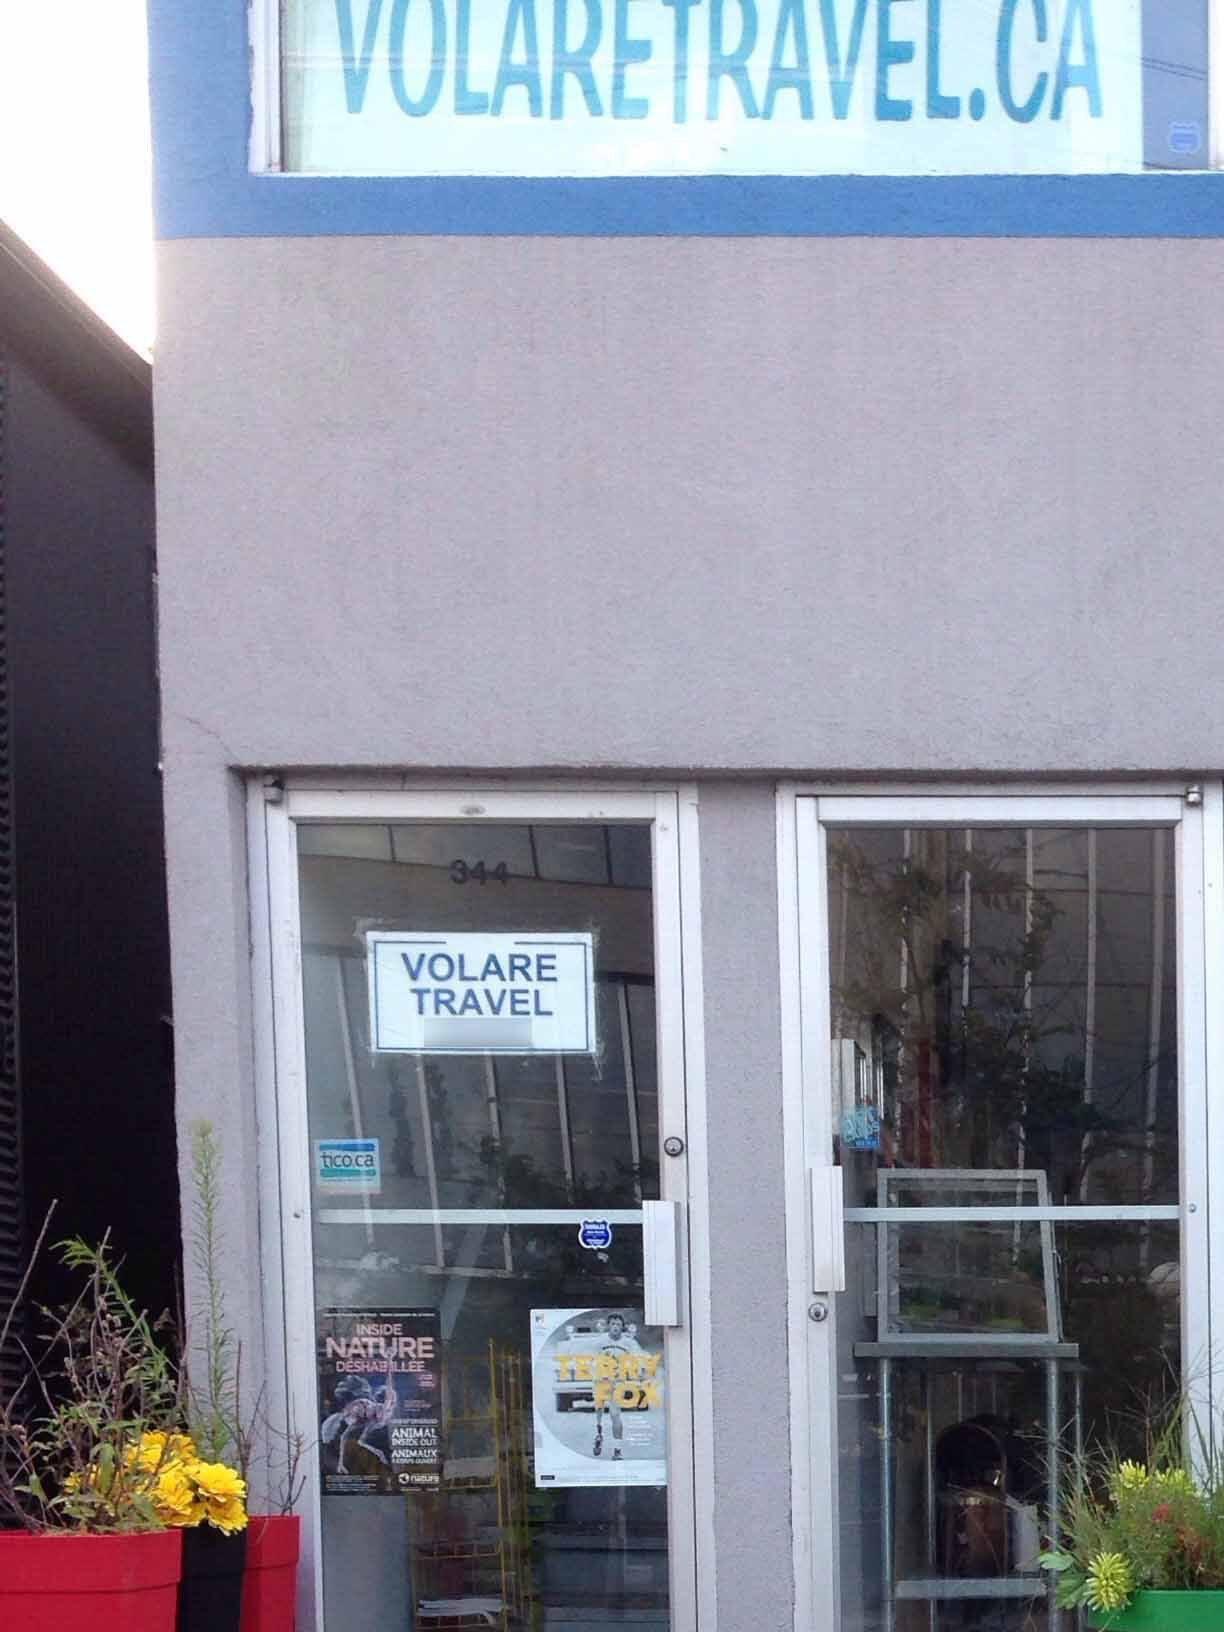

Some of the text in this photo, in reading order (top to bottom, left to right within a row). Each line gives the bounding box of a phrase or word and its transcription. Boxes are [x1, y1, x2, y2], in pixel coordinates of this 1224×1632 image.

[334, 0, 1103, 124] VOLARETRAVEL.CA
[449, 859, 512, 887] 344
[401, 952, 558, 982] VOLARE
[409, 988, 553, 1016] TRAVEL
[356, 1323, 403, 1335] INSIDE
[326, 1336, 435, 1359] NATURE
[555, 1354, 661, 1381] TERRY
[594, 1381, 661, 1409] FOX
[392, 1428, 439, 1438] ANIMAL
[392, 1449, 438, 1458] ANIMAUX
